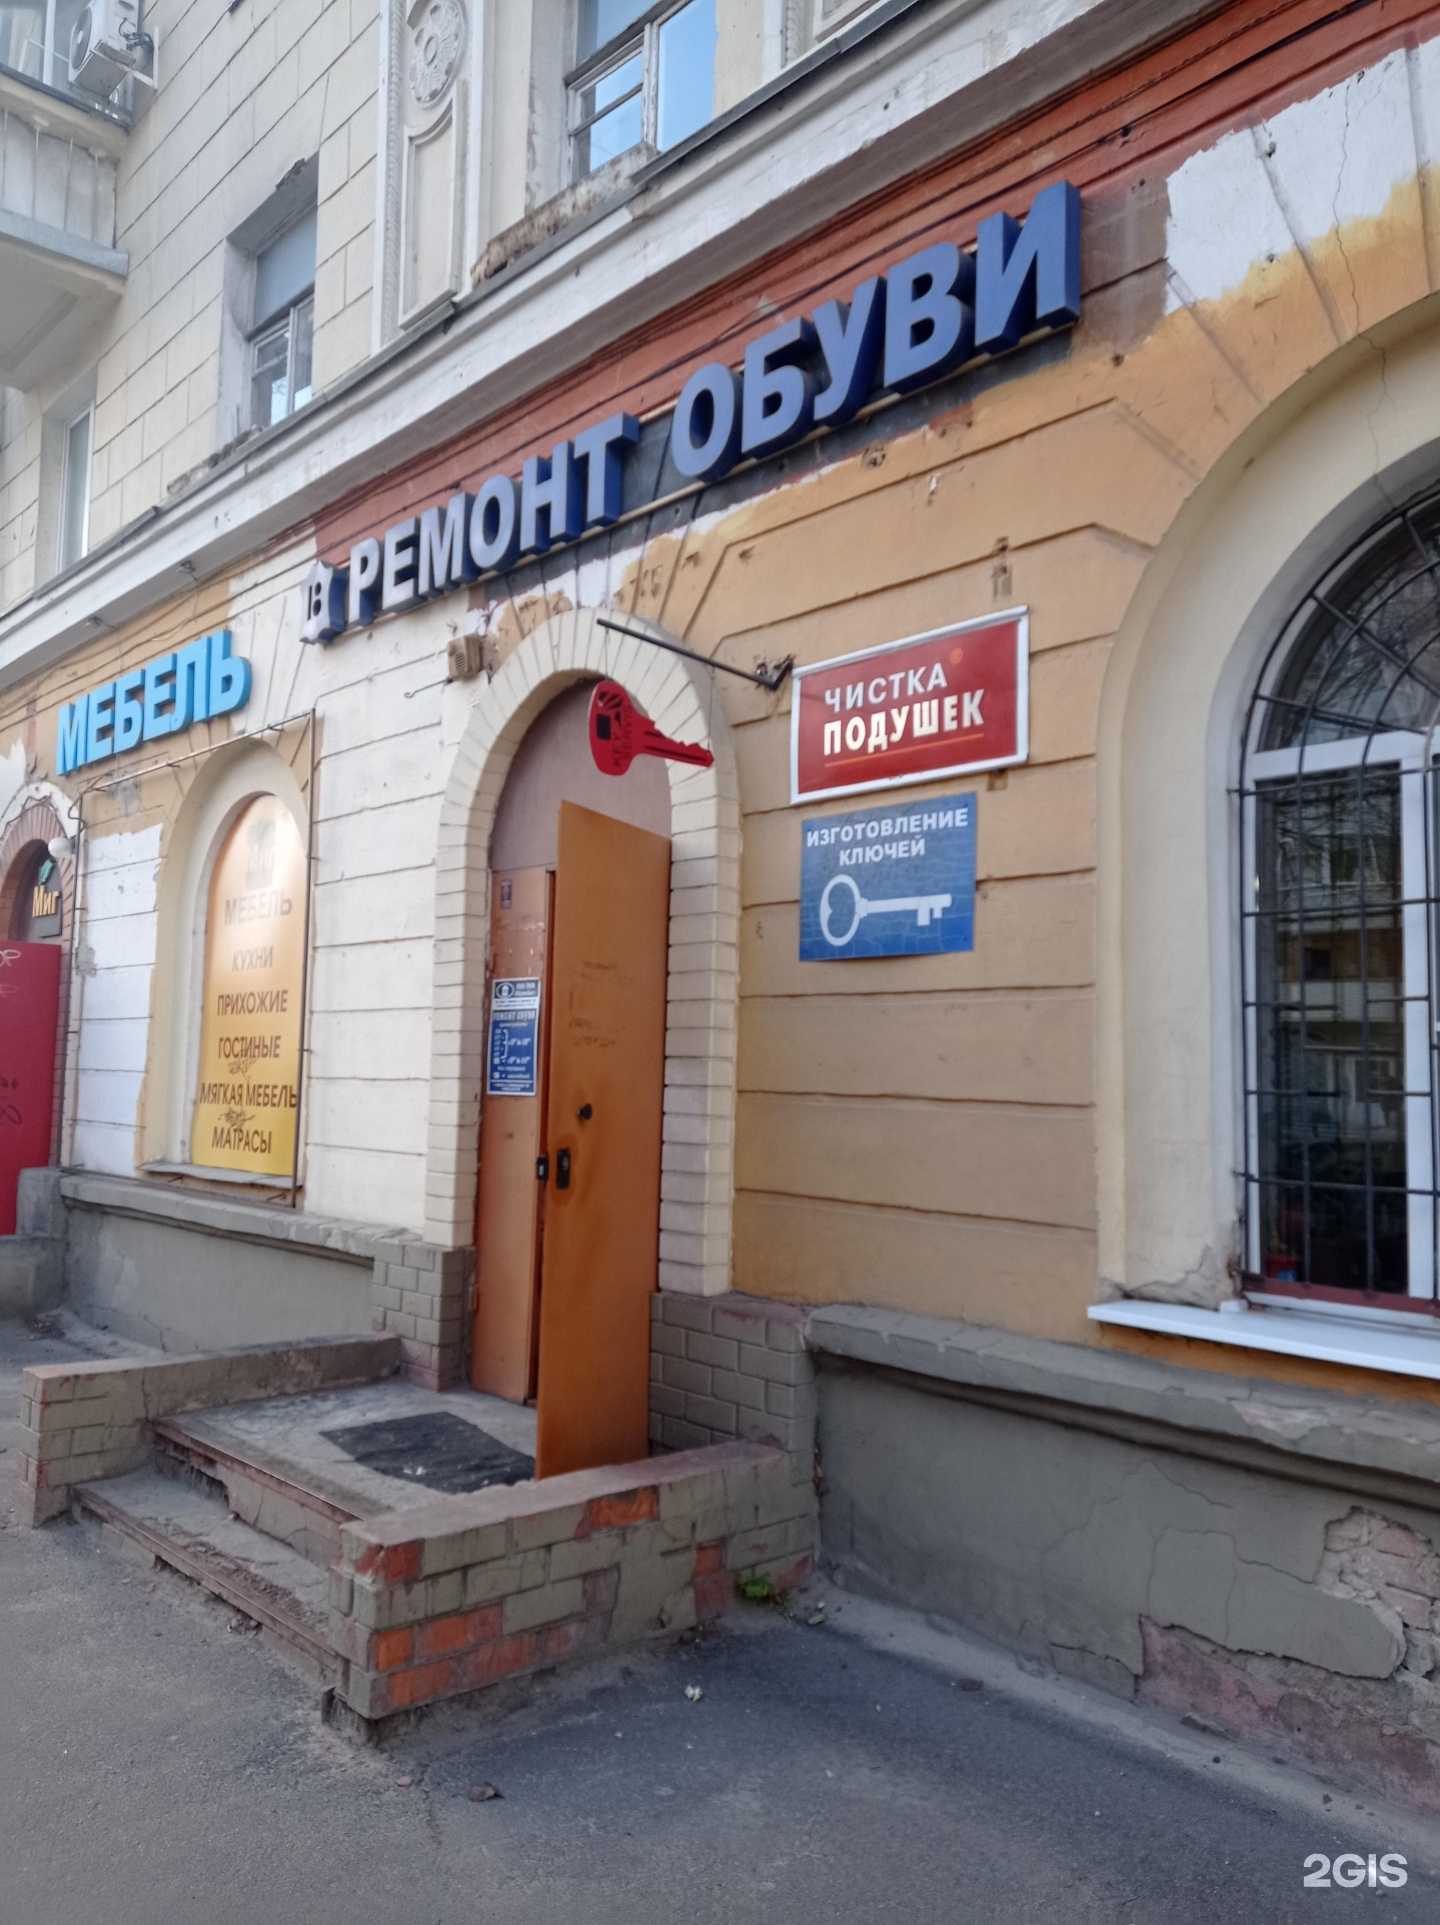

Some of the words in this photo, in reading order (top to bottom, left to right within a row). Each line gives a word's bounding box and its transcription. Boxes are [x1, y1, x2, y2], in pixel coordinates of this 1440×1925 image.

[348, 412, 637, 626] РЕМОНТ
[672, 180, 1080, 482] ОБУВИ
[56, 626, 252, 775] МЕБЕЛЬ
[825, 662, 948, 713] ЧИСТКА
[824, 688, 985, 756] ПОДУШЕК
[806, 807, 968, 847] ИЗГОТОВЛЕНИЕ
[839, 834, 925, 867] КЛЮЧЕЙ
[224, 889, 293, 926] МЕБЕЛЬ
[232, 946, 274, 972] КУХНИ
[216, 990, 289, 1017] ПРИХОЖИЕ
[218, 1035, 281, 1060] ГОСТИНЫЕ
[200, 1082, 243, 1105] МЯГКАЯ
[245, 1083, 298, 1109] МЕБЕЛЬ
[211, 1125, 273, 1154] МАТРАСЫ
